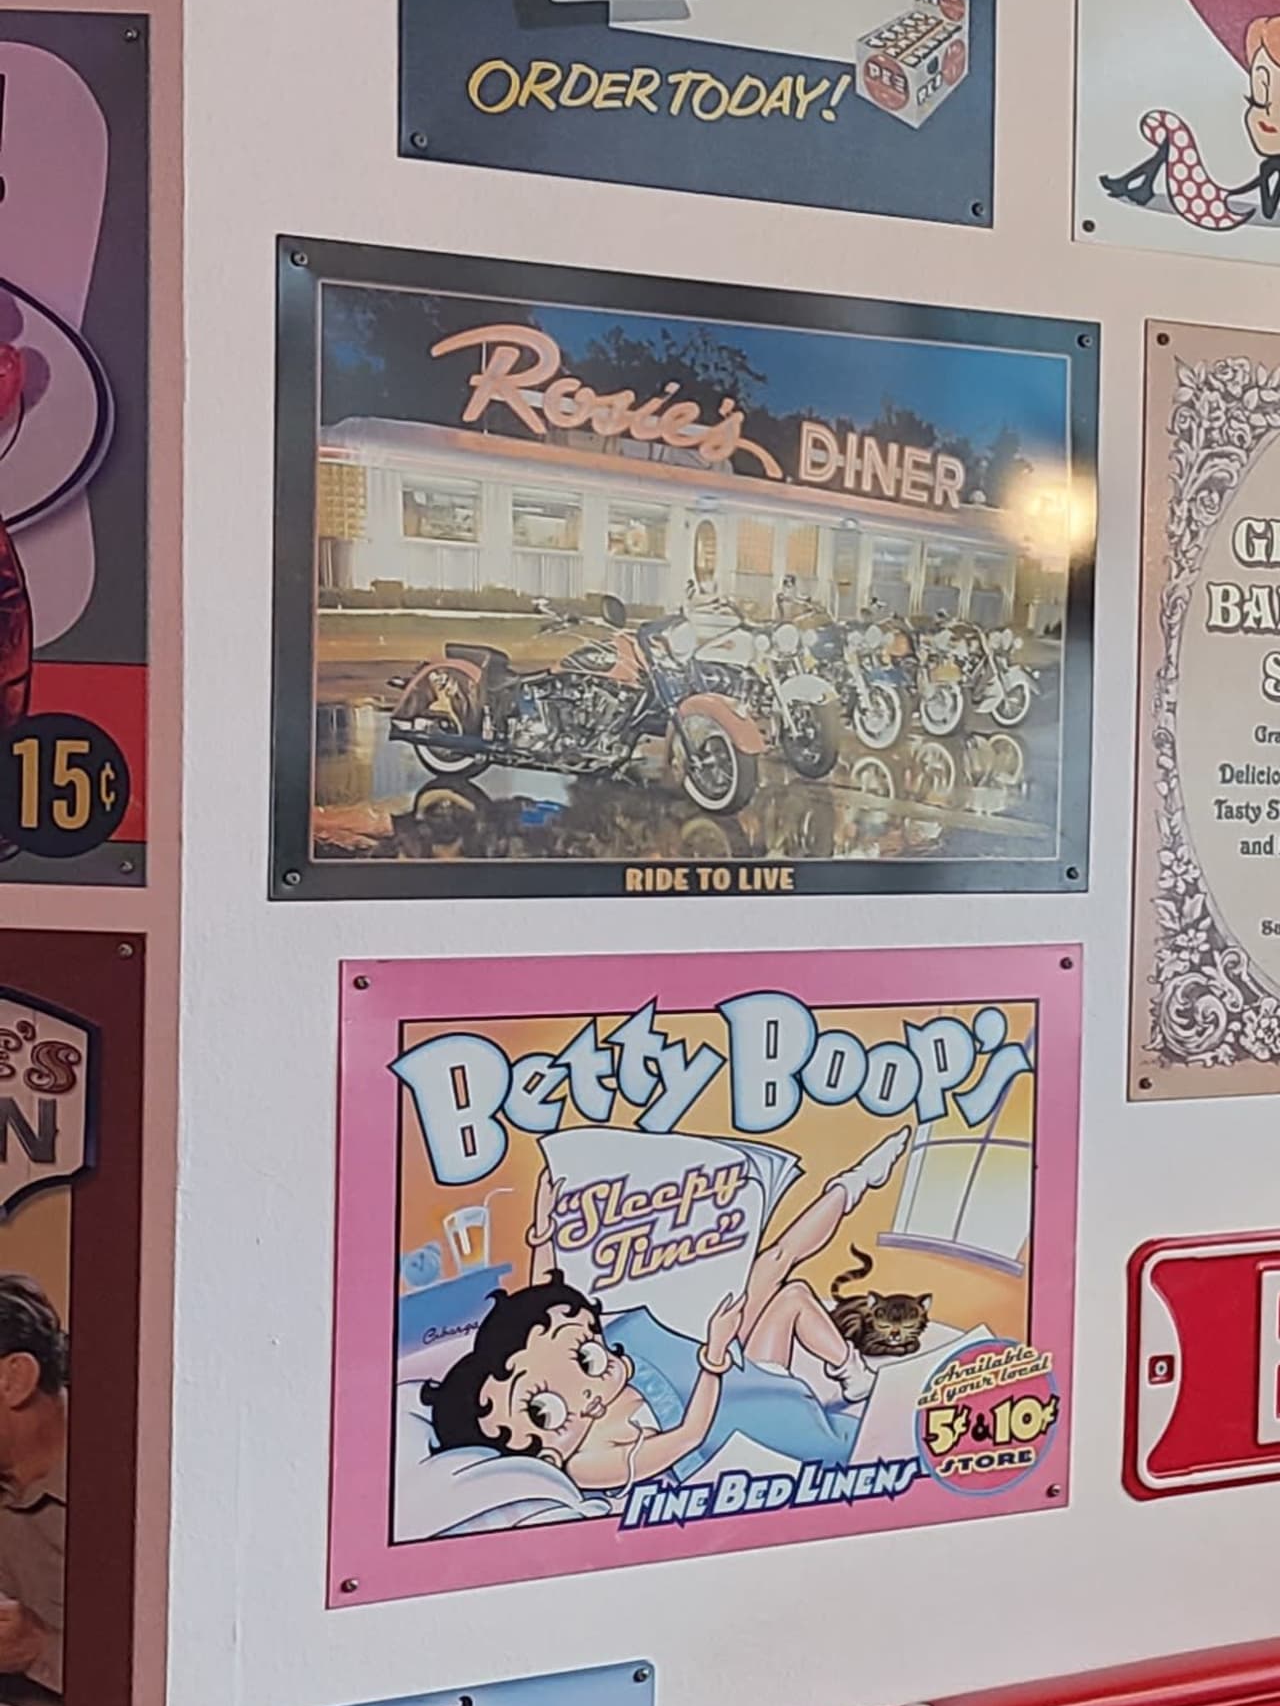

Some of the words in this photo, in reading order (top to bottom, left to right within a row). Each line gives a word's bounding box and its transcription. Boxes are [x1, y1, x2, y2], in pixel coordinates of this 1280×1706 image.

[430, 323, 783, 480] Rosie's
[797, 420, 965, 510] DINER
[13, 736, 118, 832] 15¢
[1214, 798, 1263, 824] Tasty
[1239, 835, 1276, 856] and
[624, 865, 689, 892] RIDE
[696, 866, 732, 892] TO
[738, 865, 796, 892] LIVE
[388, 994, 728, 1187] Betty
[917, 1390, 940, 1407] at
[946, 1374, 994, 1403] your
[1000, 1355, 1050, 1382] local
[933, 1346, 1036, 1387] Available
[939, 1449, 1034, 1474] STORE
